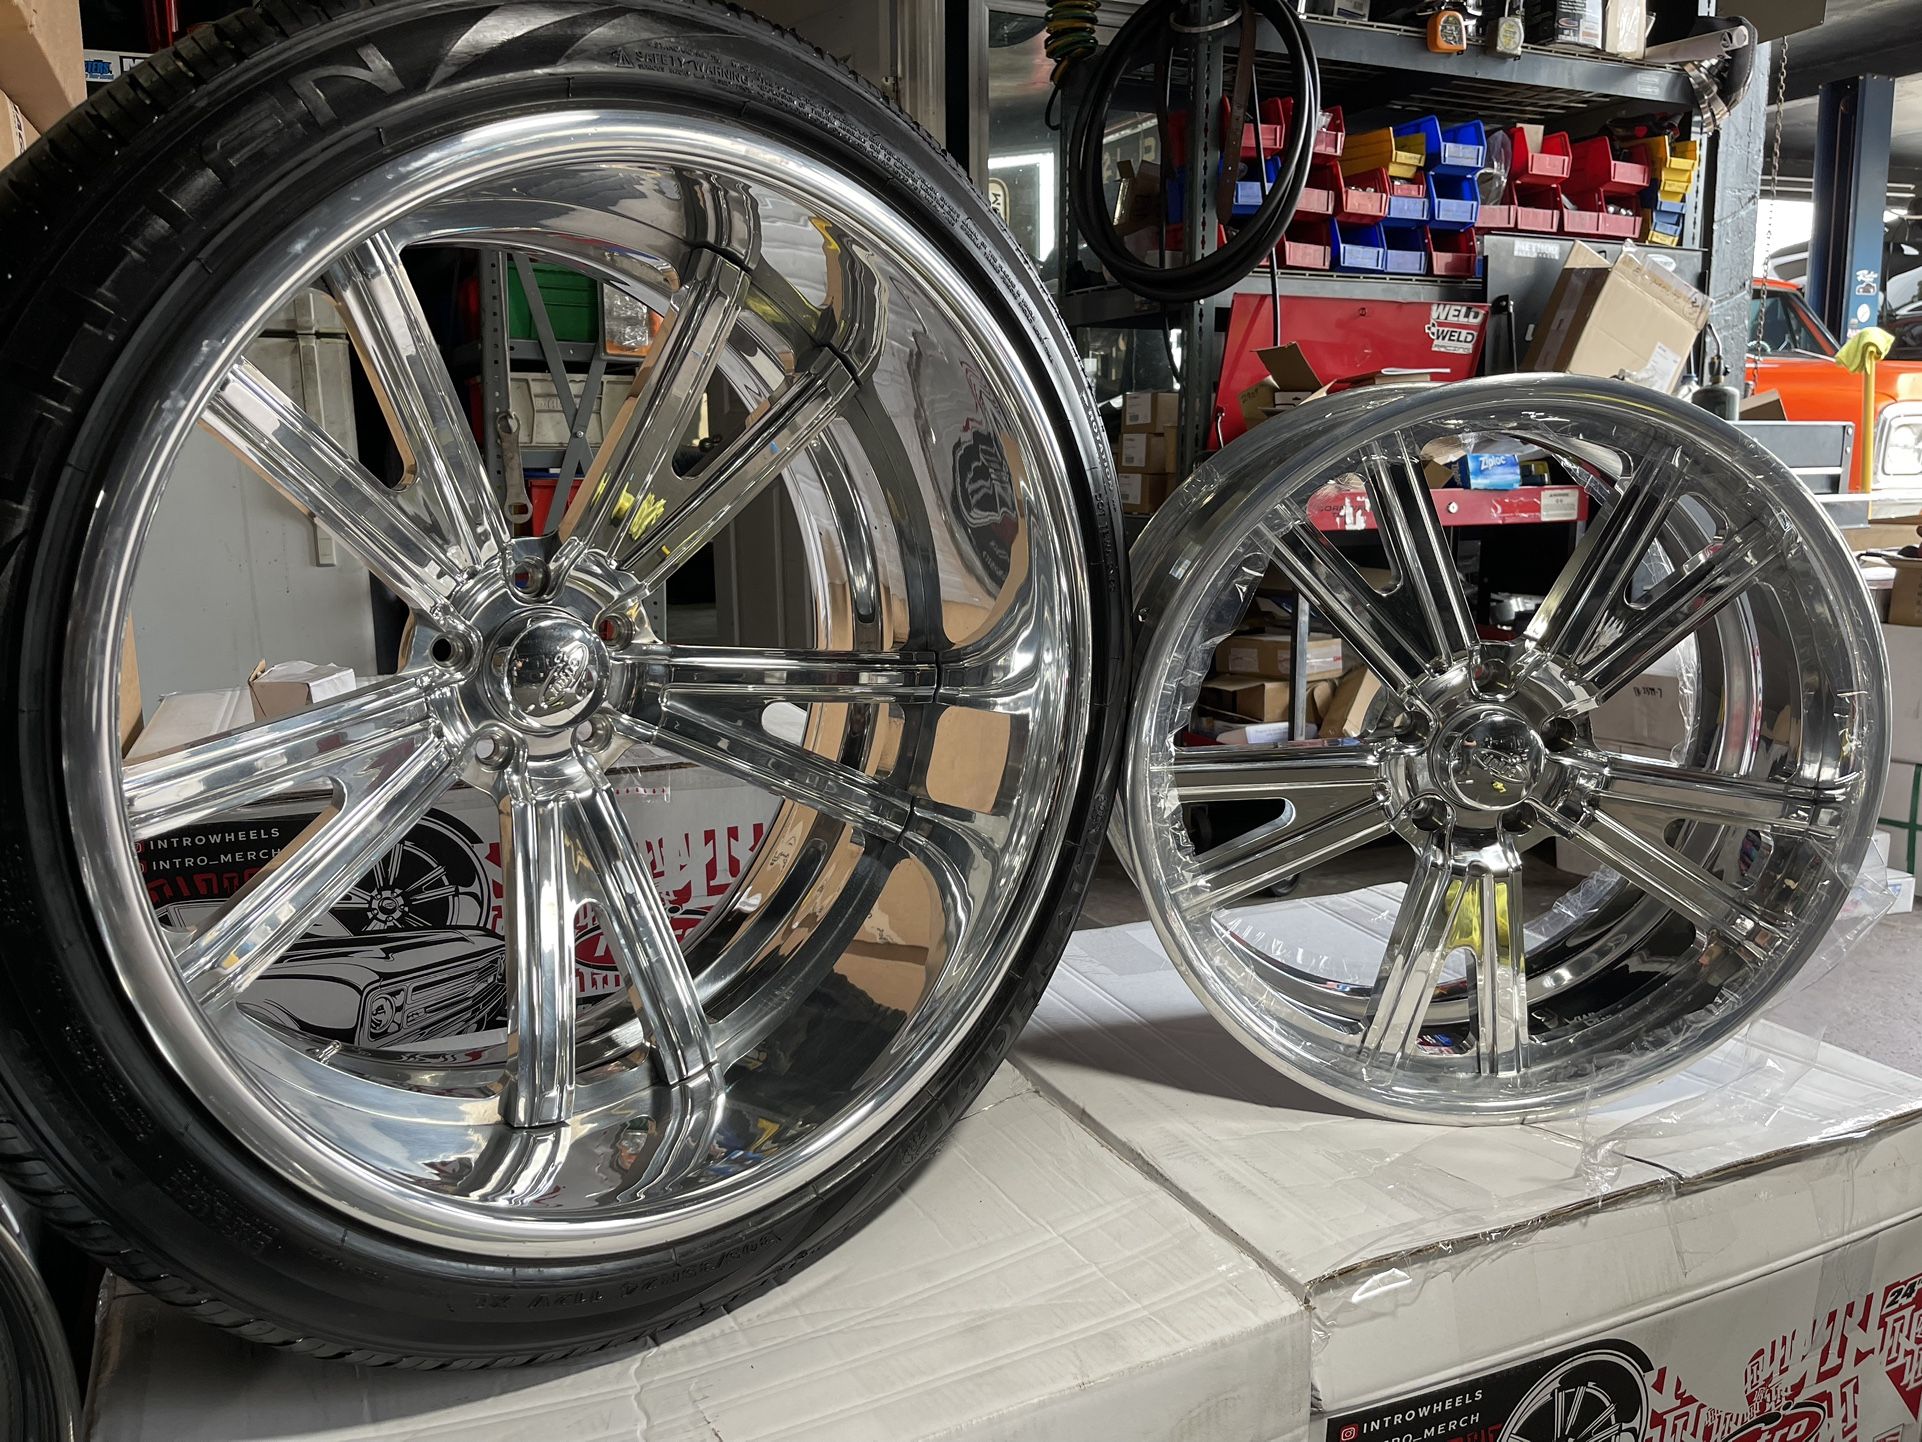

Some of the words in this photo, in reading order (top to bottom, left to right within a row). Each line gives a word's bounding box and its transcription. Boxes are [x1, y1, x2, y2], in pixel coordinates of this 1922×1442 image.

[1431, 304, 1484, 323] WELD
[1436, 329, 1475, 343] WELD
[1088, 410, 1113, 490] ROTATION
[1480, 455, 1506, 470] Ziploc
[150, 828, 280, 850] INTROWHEELS
[153, 848, 281, 871] INTRO_MERCH
[1362, 1389, 1483, 1434] INTROWHEELS
